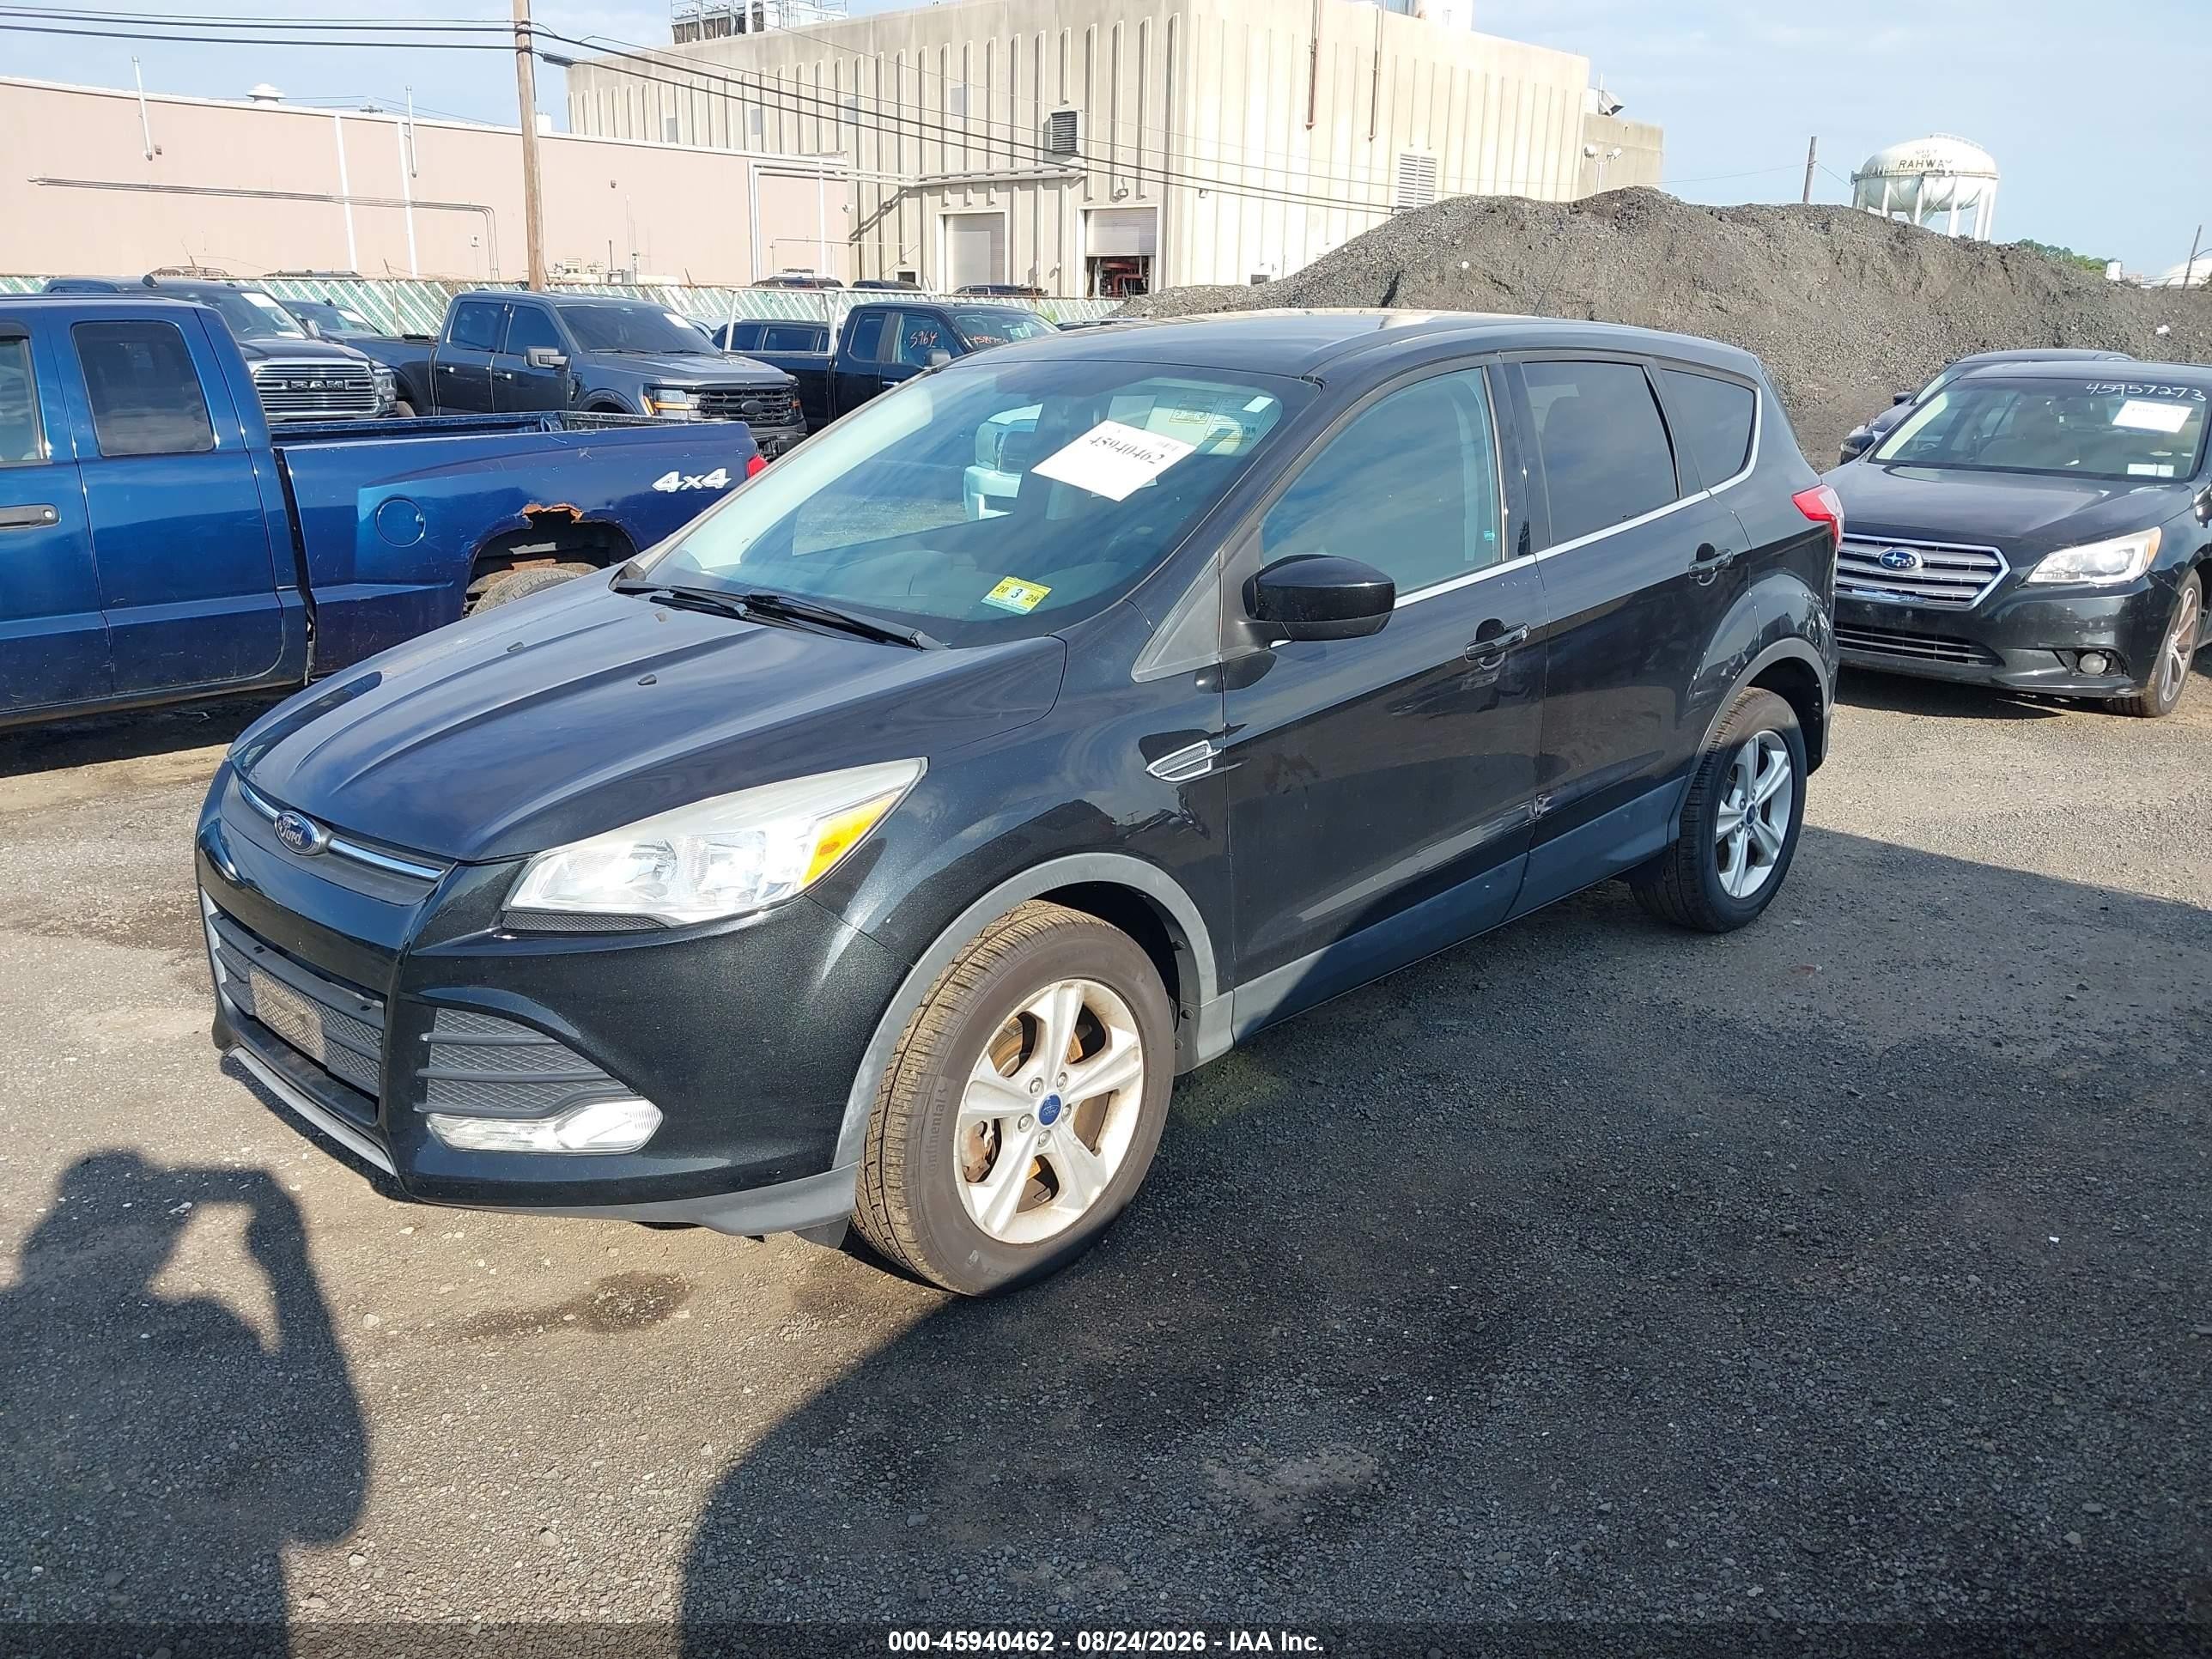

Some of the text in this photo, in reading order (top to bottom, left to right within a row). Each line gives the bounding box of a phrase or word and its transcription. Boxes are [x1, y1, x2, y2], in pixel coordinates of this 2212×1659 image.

[1898, 159, 1954, 169] RAHWAY
[290, 380, 344, 390] RAM
[2086, 382, 2208, 402] 45957273
[1089, 435, 1166, 465] 45940462
[651, 467, 732, 493] 4x4
[995, 585, 1010, 593] 20
[1011, 588, 1024, 599] 3
[1025, 594, 1040, 603] 28
[276, 814, 305, 846] Ford
